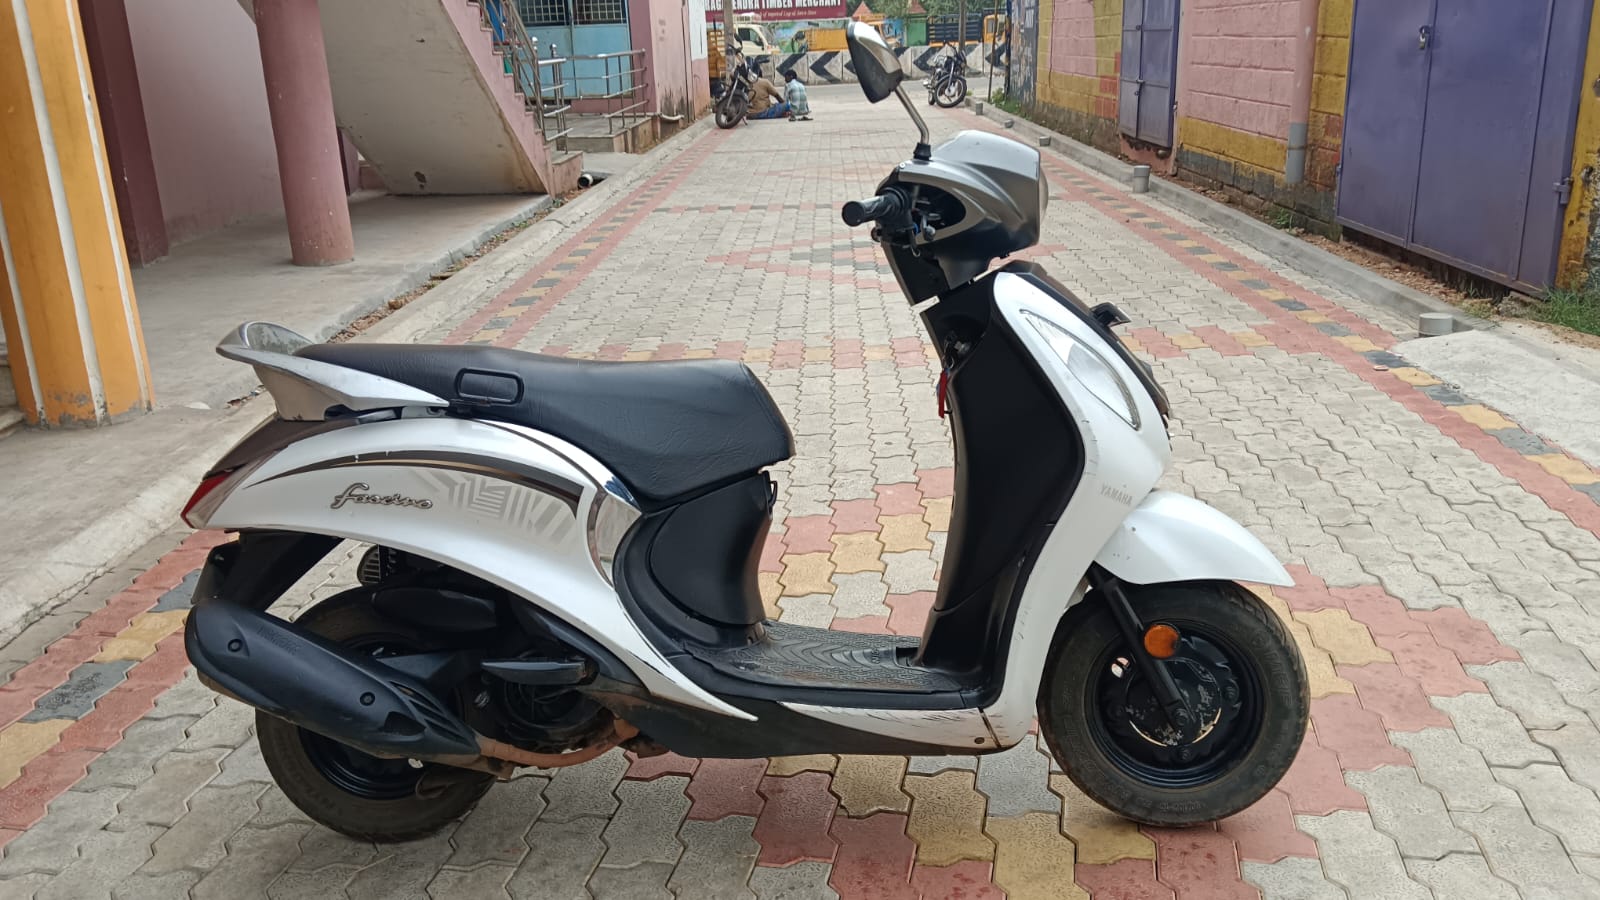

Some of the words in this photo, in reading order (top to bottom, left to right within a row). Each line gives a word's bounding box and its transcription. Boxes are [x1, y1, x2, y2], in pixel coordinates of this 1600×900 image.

[761, 0, 793, 9] TIMBER
[795, 0, 841, 8] MERCHANT
[1100, 482, 1133, 505] YAMAHA
